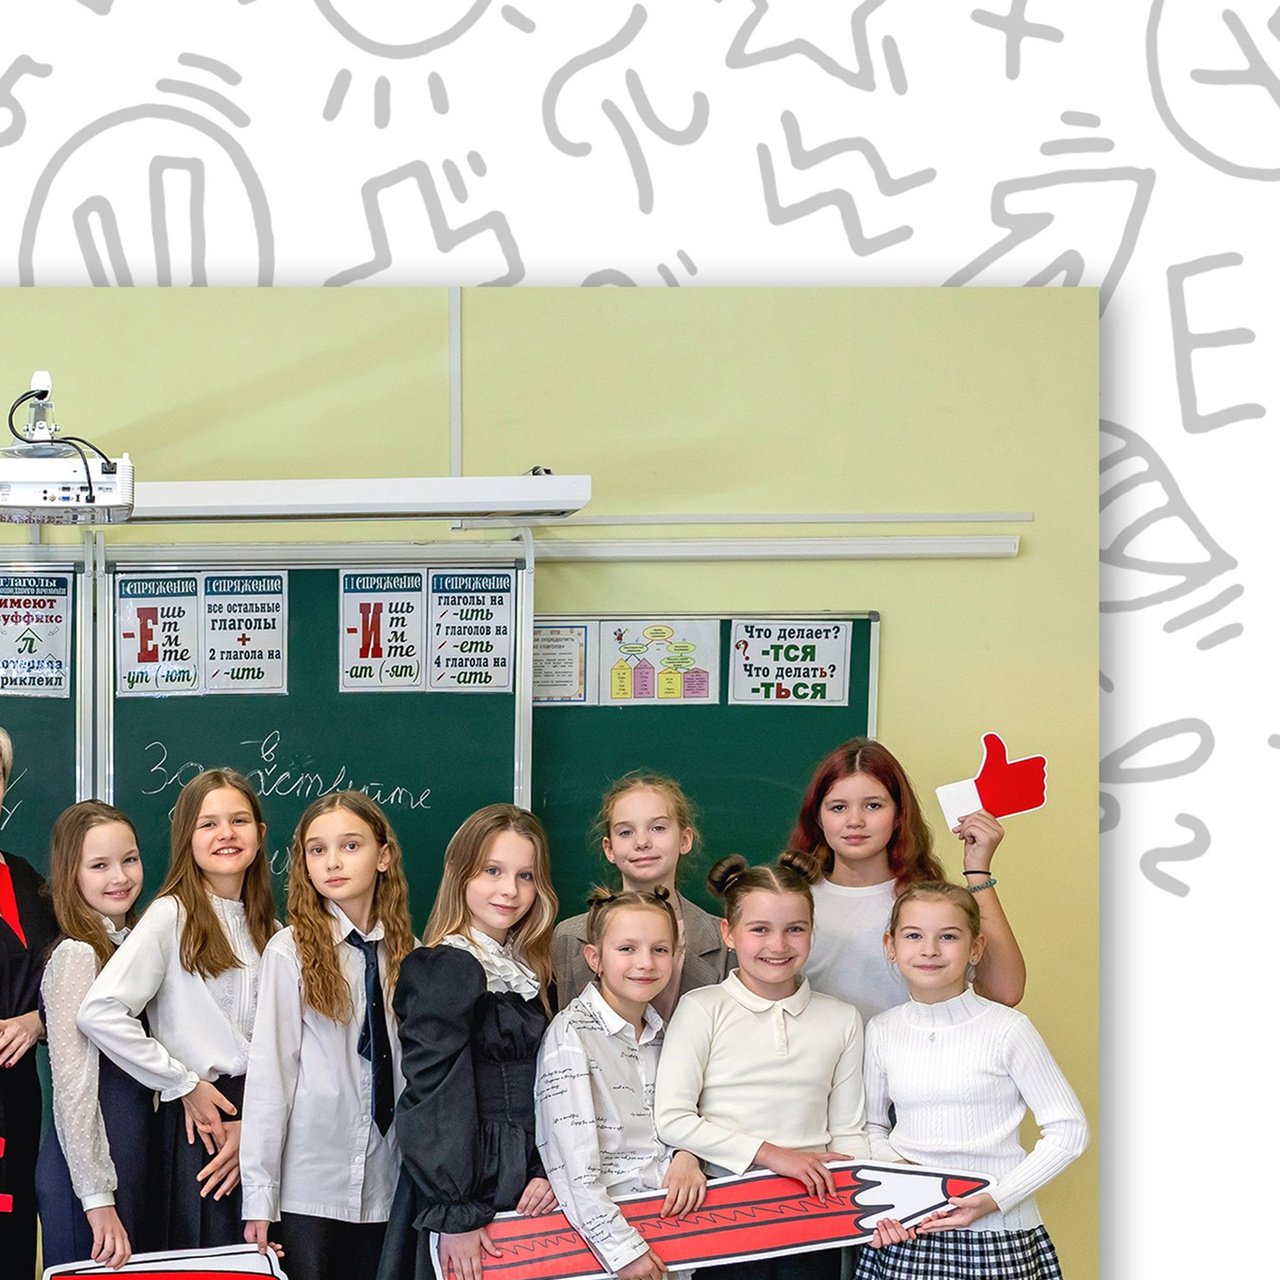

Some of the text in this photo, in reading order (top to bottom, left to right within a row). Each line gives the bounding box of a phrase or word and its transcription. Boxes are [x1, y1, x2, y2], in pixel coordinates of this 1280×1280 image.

[0, 578, 57, 588] глаголы
[127, 580, 196, 596] СПРЯЖЕНИЕ
[212, 578, 282, 595] СПРЯЖЕНИЕ
[356, 575, 421, 591] СПРЯЖЕНИЕ
[444, 575, 510, 591] СПРЯЖЕНИЕ
[207, 602, 281, 614] все остальные
[438, 596, 504, 606] глаголы на
[210, 617, 276, 631] глаголы
[435, 623, 508, 636] 7 глаголов на
[744, 625, 841, 641] Что делает?
[209, 648, 281, 661] 2 глагола на
[434, 655, 507, 668] 4 глагола на
[743, 664, 837, 680] Что делать?
